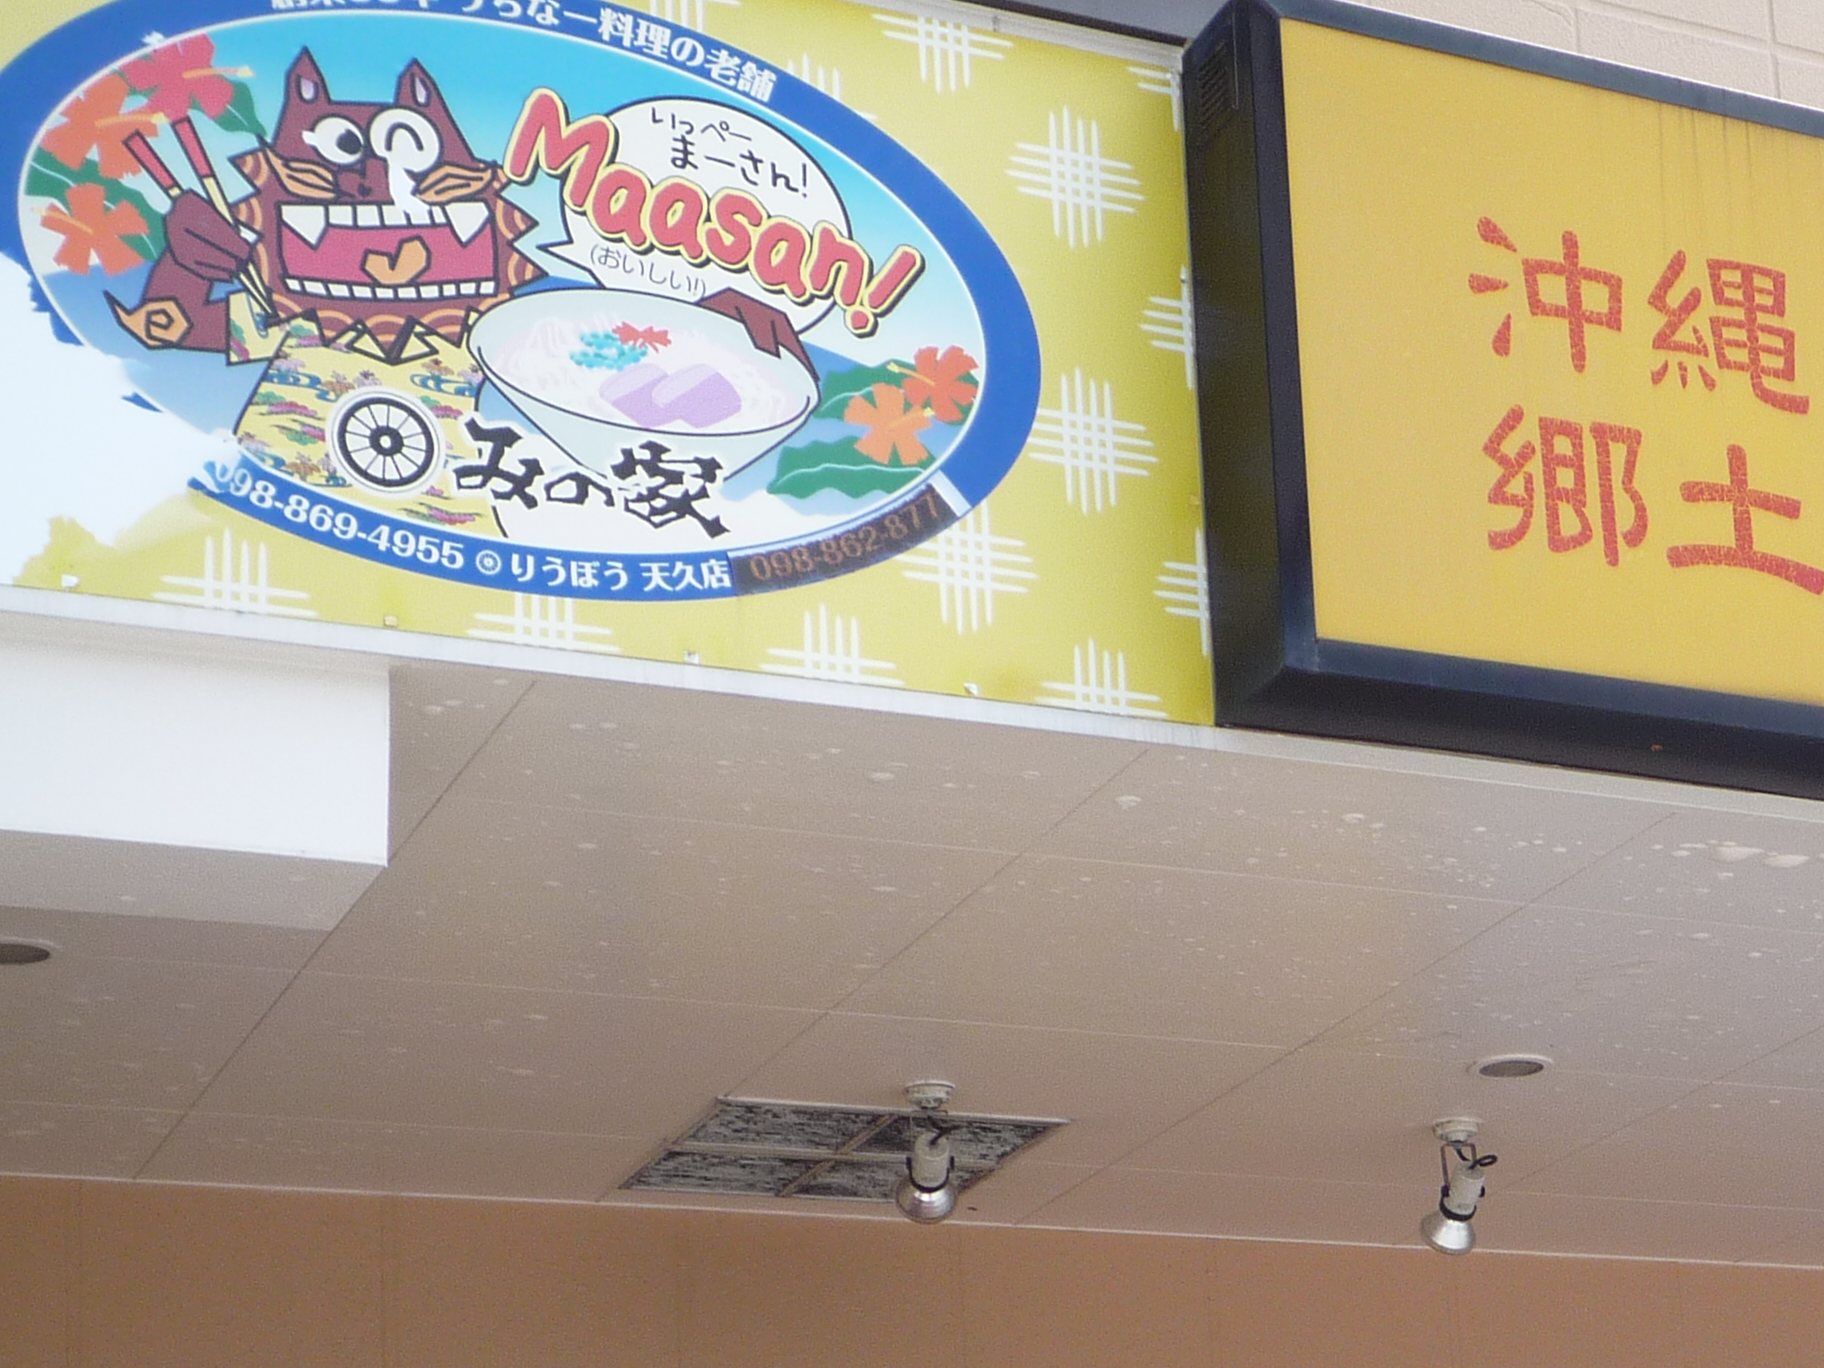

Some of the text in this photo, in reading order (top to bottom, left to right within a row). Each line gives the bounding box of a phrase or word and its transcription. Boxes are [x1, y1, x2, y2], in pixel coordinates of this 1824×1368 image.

[651, 106, 752, 144] いっぺー
[669, 136, 809, 199] まーさん!
[504, 88, 925, 337] Maasan!
[453, 418, 731, 539] みの家
[509, 551, 630, 591] りうぼう
[639, 551, 733, 592] 天久店
